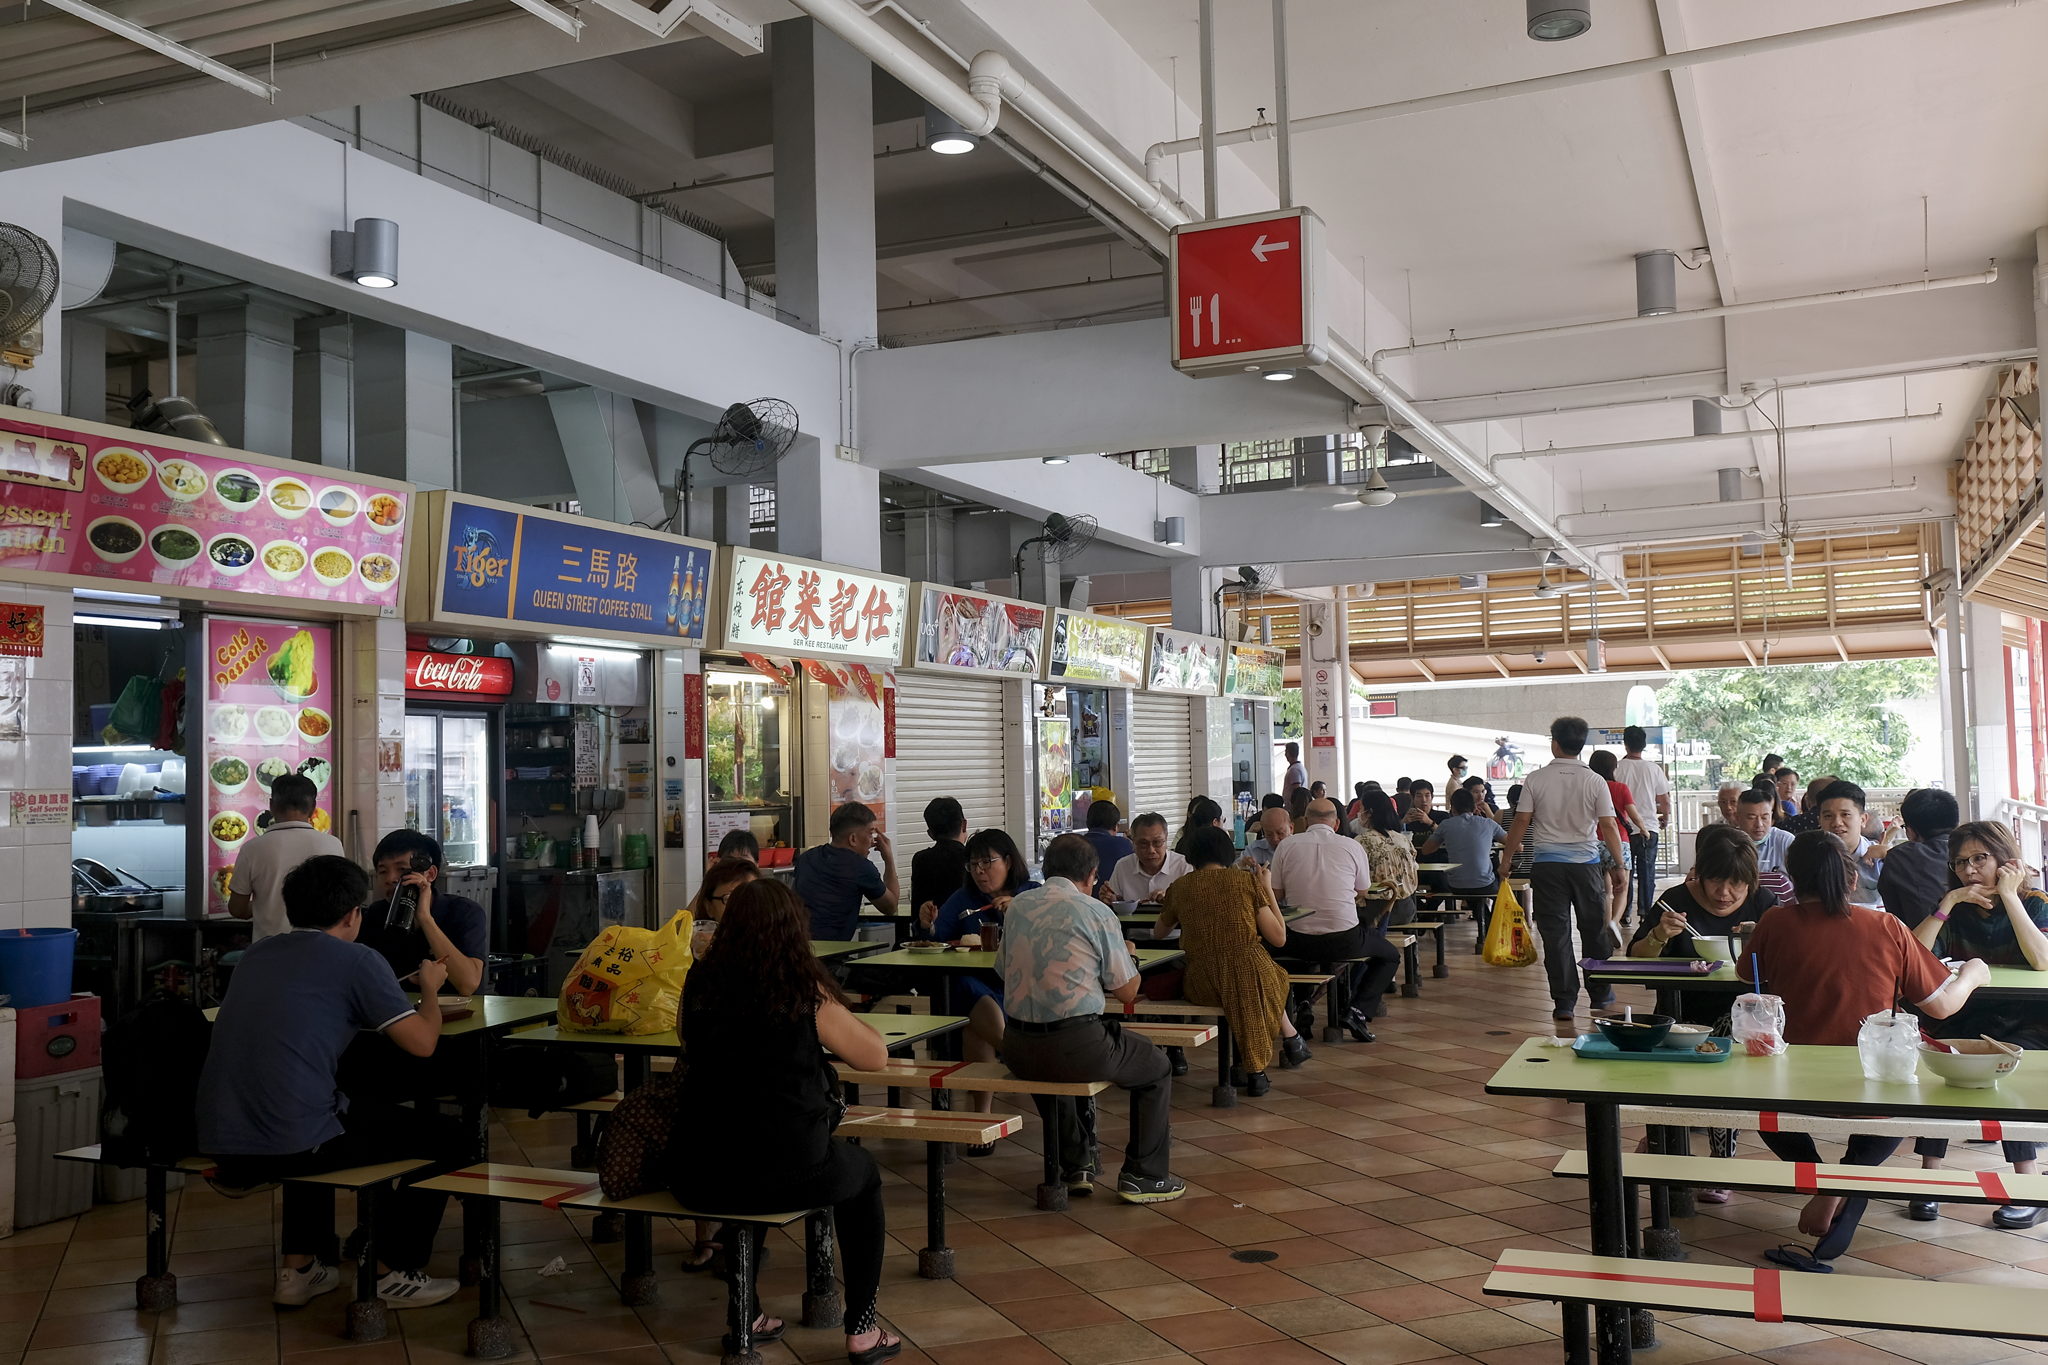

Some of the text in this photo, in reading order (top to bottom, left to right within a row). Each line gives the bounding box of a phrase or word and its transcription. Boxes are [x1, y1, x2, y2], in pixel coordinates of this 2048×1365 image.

[453, 545, 509, 587] Tiger
[557, 544, 639, 593] 三馬路
[533, 589, 653, 621] QUEEN STREET COFFEE STALL
[215, 636, 269, 691] Dessert
[216, 627, 250, 666] Cold
[793, 638, 848, 651] SER KEE RESTAURANT
[415, 654, 484, 690] Coca-Cola
